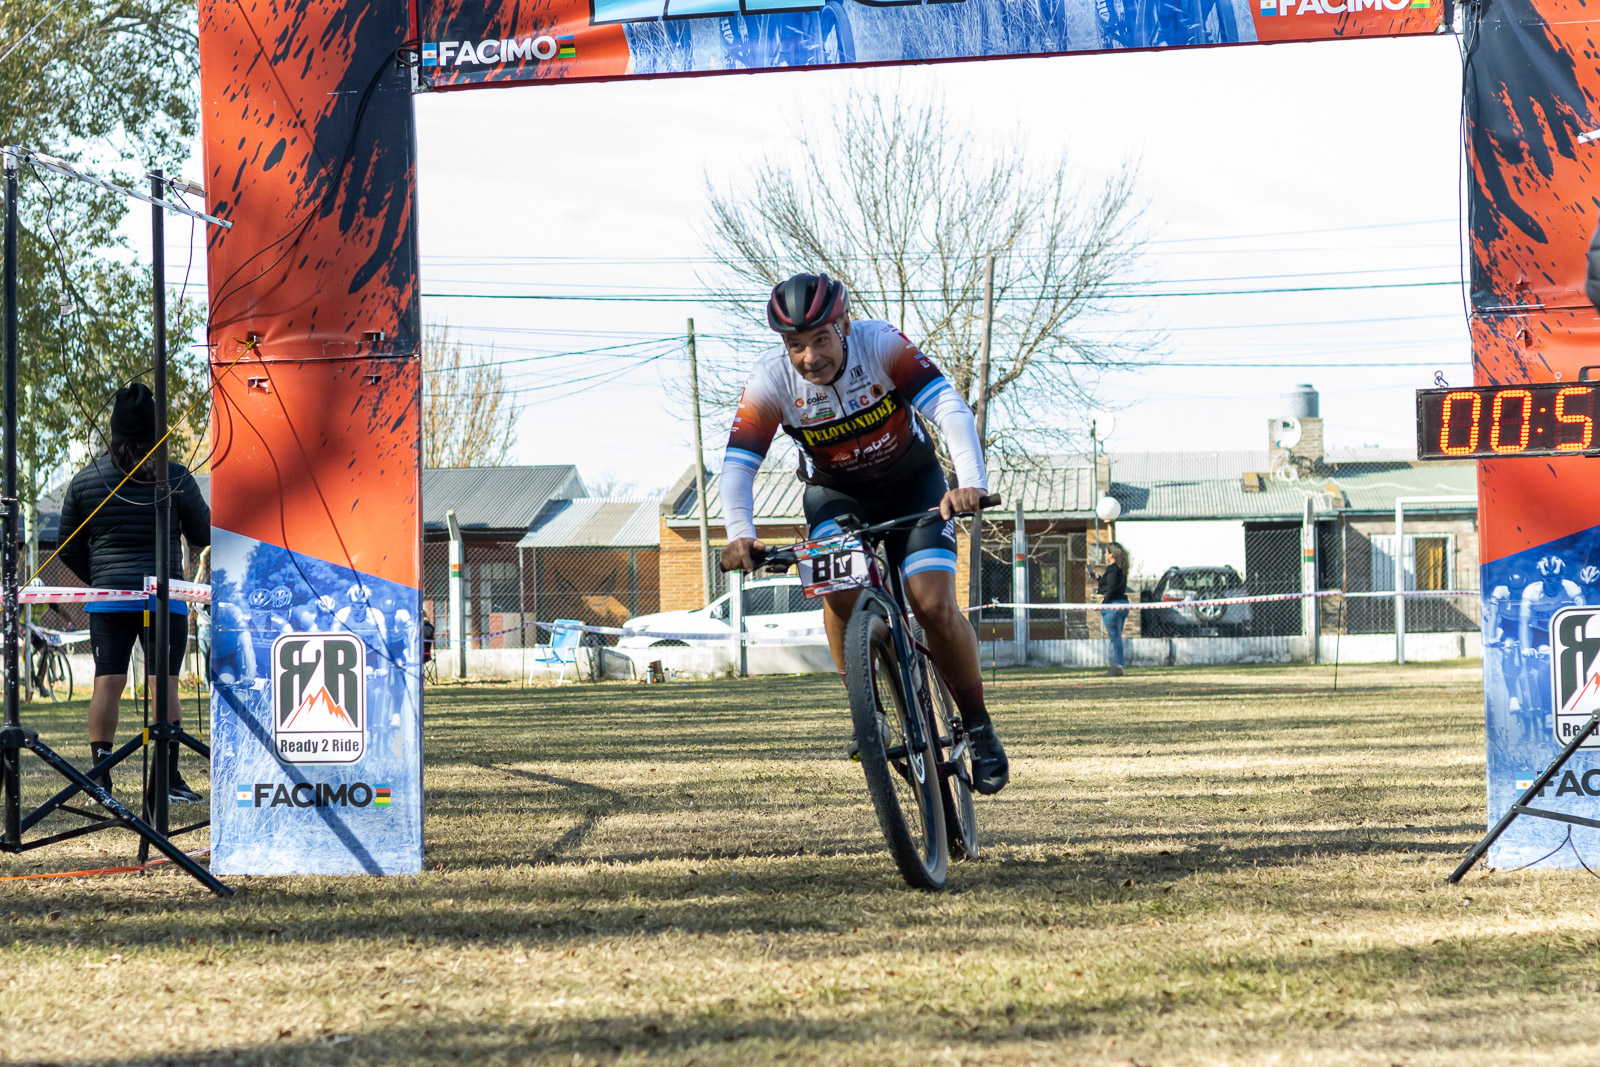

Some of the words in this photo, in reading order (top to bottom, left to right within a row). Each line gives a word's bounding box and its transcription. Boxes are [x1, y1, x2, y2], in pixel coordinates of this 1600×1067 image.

[439, 35, 557, 66] FACIMO
[280, 739, 318, 753] Ready
[321, 739, 329, 752] 2
[332, 739, 359, 752] Ride
[254, 782, 373, 808] FACIMO
